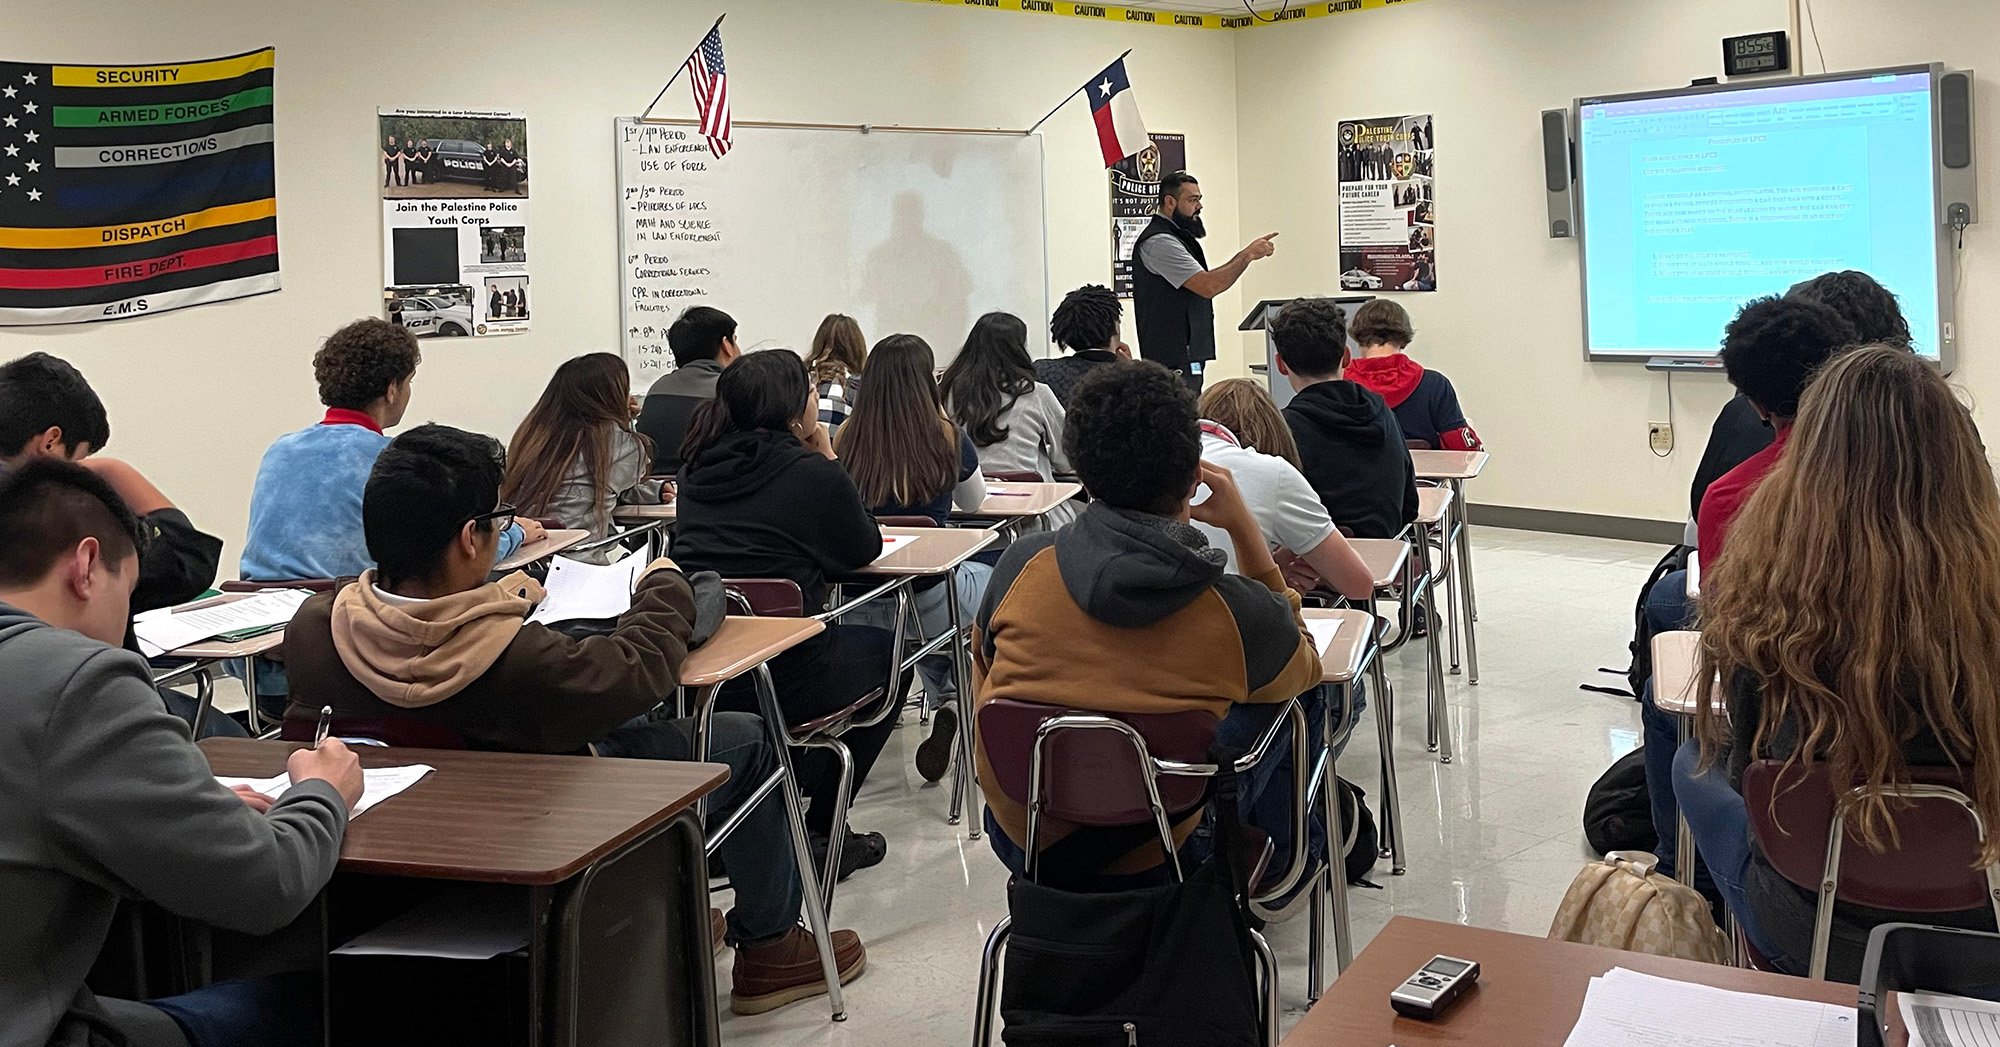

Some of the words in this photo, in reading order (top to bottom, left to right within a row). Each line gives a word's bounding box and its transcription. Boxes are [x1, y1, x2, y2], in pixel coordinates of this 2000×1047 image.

[1021, 0, 1053, 12] CAUTION
[1074, 5, 1105, 17] CAUTION
[1126, 10, 1155, 22] CAUTION
[1174, 14, 1202, 26] CAUTION
[1221, 17, 1253, 28] CAUTION
[1274, 8, 1306, 20] CAUTION
[1328, 0, 1362, 13] CAUTION
[96, 69, 179, 83] SECURITY
[98, 109, 159, 123] ARMED
[165, 100, 230, 120] FORCES
[659, 126, 686, 140] PERIOD
[99, 138, 218, 163] CORRECTIONS
[665, 144, 710, 154] ENFORCEMEN
[444, 159, 485, 170] POLICE
[641, 160, 659, 171] USE
[664, 160, 677, 171] OF
[681, 159, 707, 171] FORCE
[659, 186, 685, 197] PERIOD
[1121, 180, 1147, 194] POLICE
[396, 203, 418, 212] Join
[421, 203, 438, 212] the
[441, 202, 487, 212] Palestine
[489, 202, 518, 211] Police
[675, 201, 686, 210] OF
[428, 216, 458, 225] Youth
[461, 215, 490, 226] Corps
[636, 218, 656, 229] MATH
[660, 219, 676, 229] AND
[678, 219, 711, 230] SCIENCE
[102, 219, 186, 242] DISPATCH
[637, 232, 647, 240] IN
[652, 231, 667, 240] LAW
[670, 230, 721, 242] ENFORCEMENT
[644, 253, 669, 264] PERIOD
[105, 264, 144, 280] FIRE
[149, 255, 187, 274] DEPT.
[632, 286, 648, 299] CPR
[652, 290, 659, 298] IN
[103, 300, 149, 315] E.M.S
